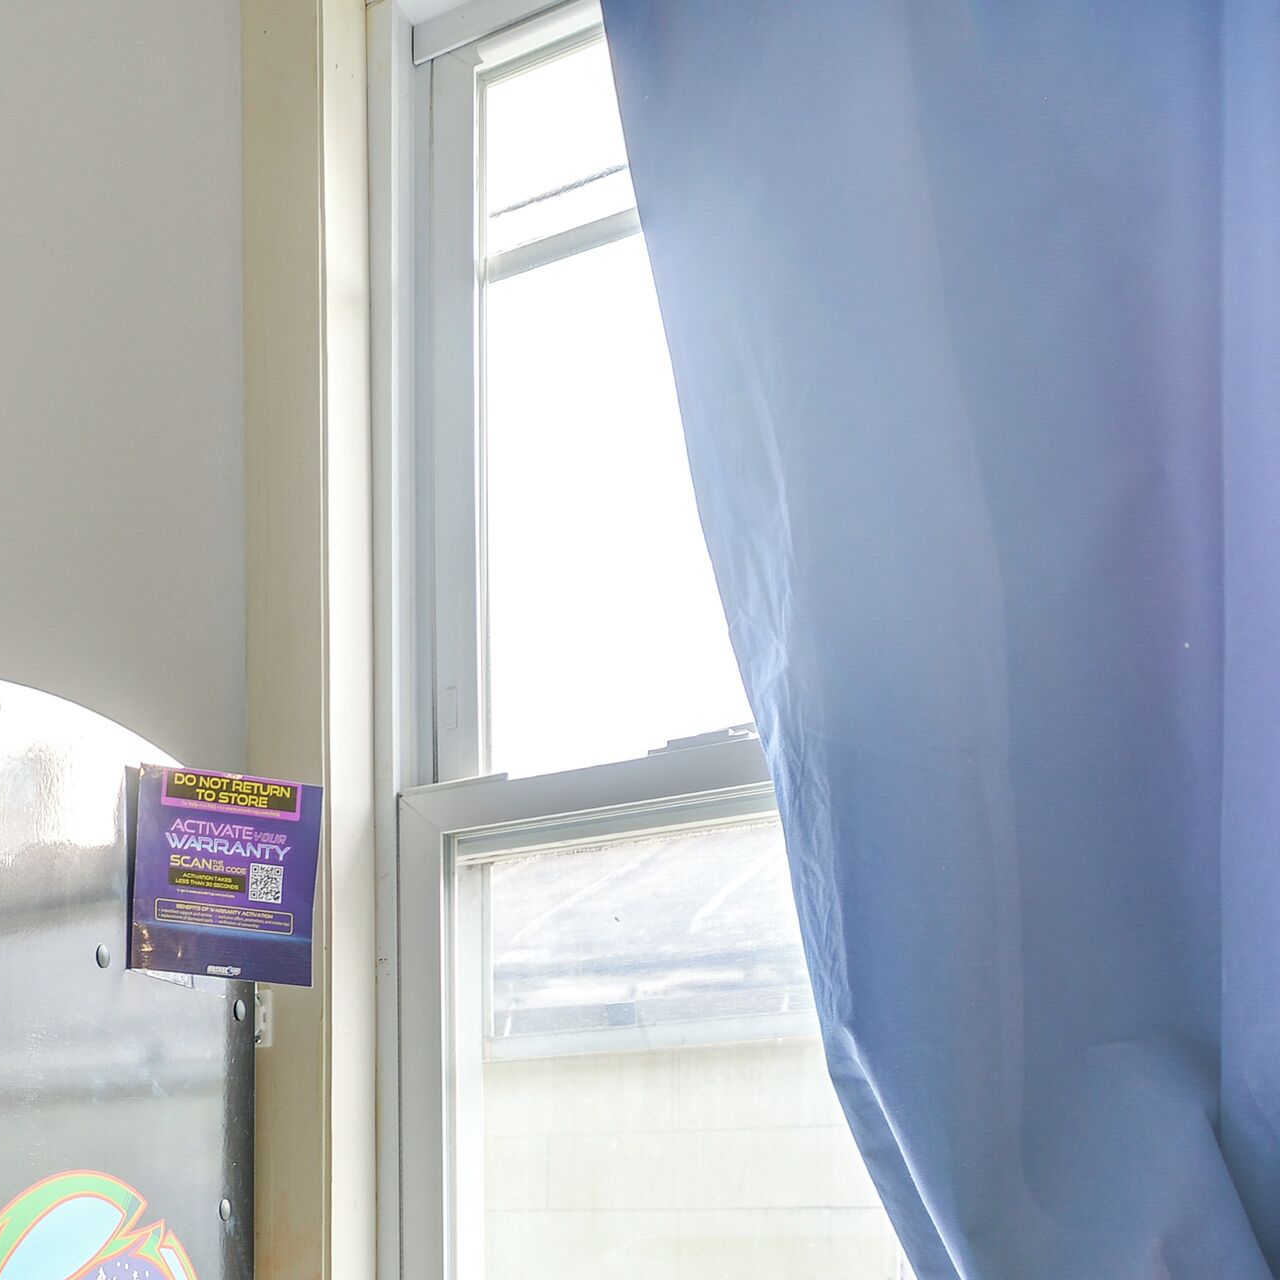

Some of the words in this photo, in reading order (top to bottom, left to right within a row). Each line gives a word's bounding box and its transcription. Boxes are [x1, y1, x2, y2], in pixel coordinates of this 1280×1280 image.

[174, 772, 197, 786] DO
[199, 776, 230, 790] NOT
[232, 780, 291, 798] RETURN
[195, 788, 216, 802] TO
[218, 791, 269, 808] STORE
[170, 818, 254, 840] ACTIVATE
[253, 831, 288, 845] YOUR
[165, 832, 292, 861] WARRANTY
[170, 854, 212, 870] SCAN
[225, 866, 247, 874] CODE
[182, 872, 213, 881] ACTIVATION
